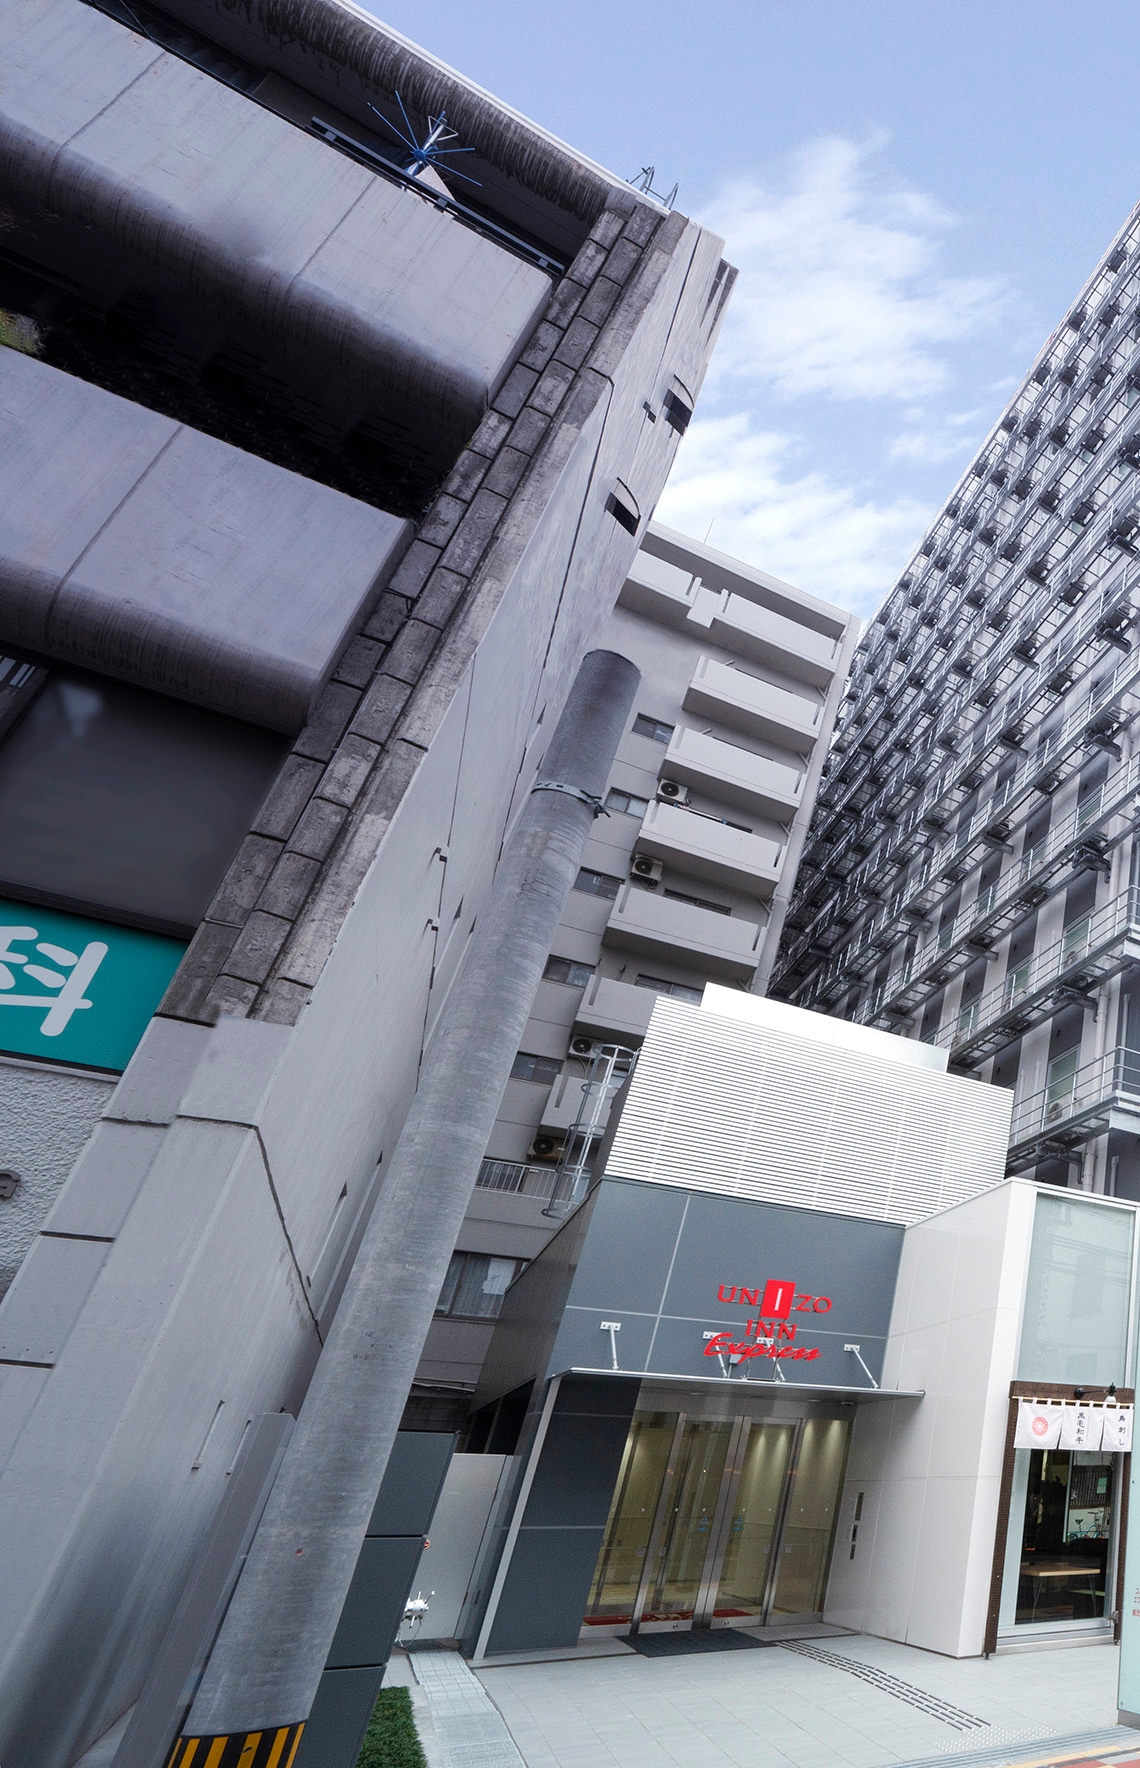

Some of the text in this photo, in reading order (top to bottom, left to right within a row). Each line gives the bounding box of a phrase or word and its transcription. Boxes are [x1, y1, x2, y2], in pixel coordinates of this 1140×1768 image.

[717, 1282, 833, 1315] UNIZO
[745, 1319, 797, 1340] INN
[703, 1332, 823, 1365] Express
